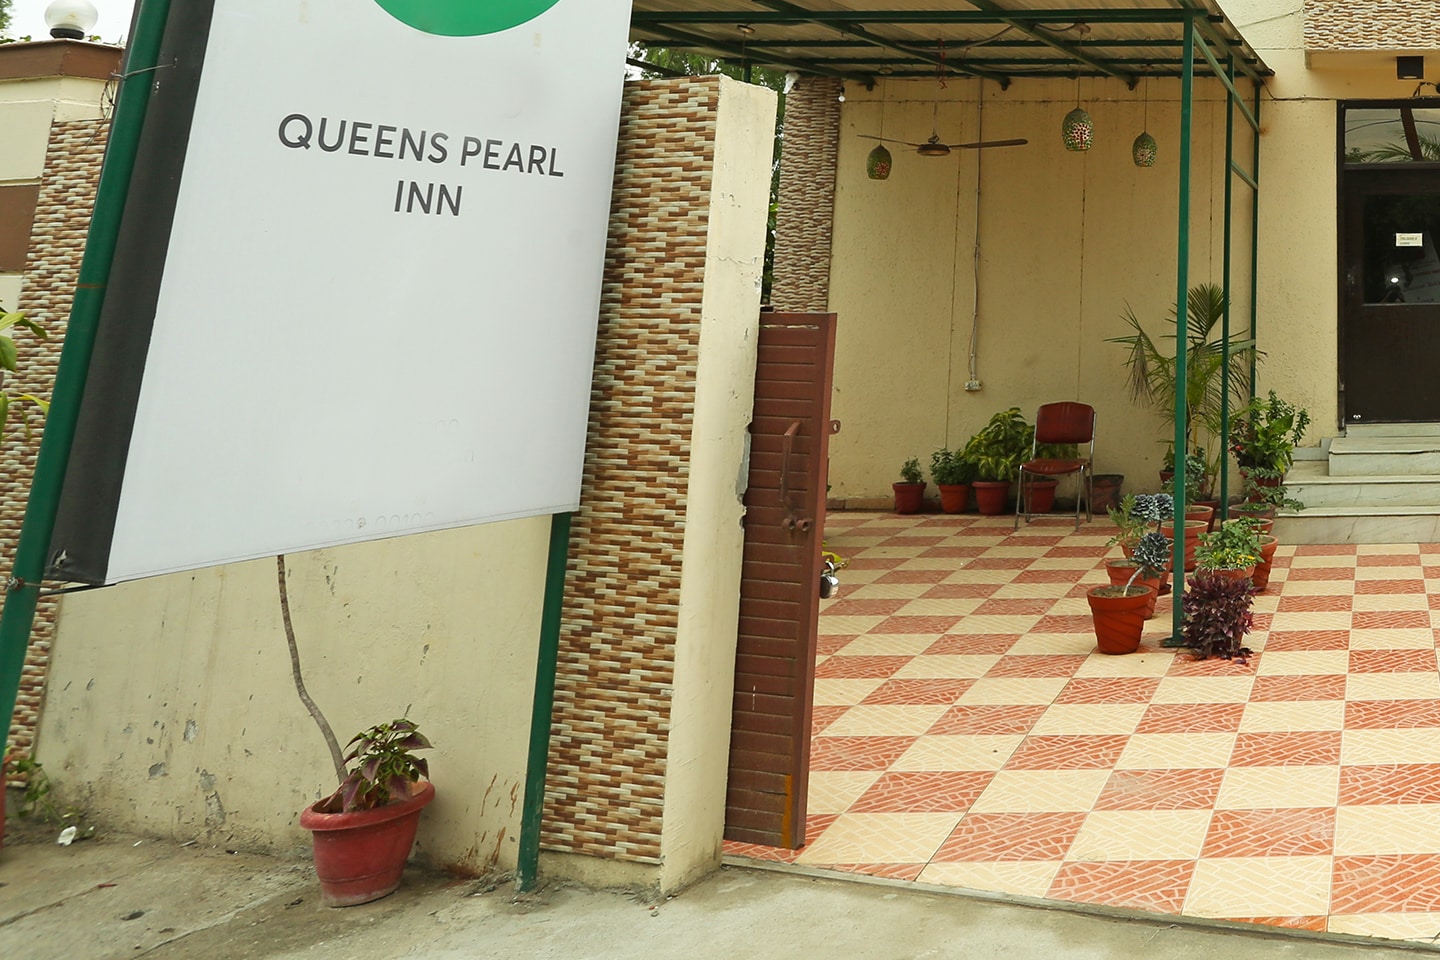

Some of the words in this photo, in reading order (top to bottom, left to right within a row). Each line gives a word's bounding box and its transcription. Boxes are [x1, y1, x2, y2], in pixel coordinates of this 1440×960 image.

[278, 113, 449, 164] QUEENS
[460, 136, 564, 177] PEARL
[394, 180, 463, 216] INN
